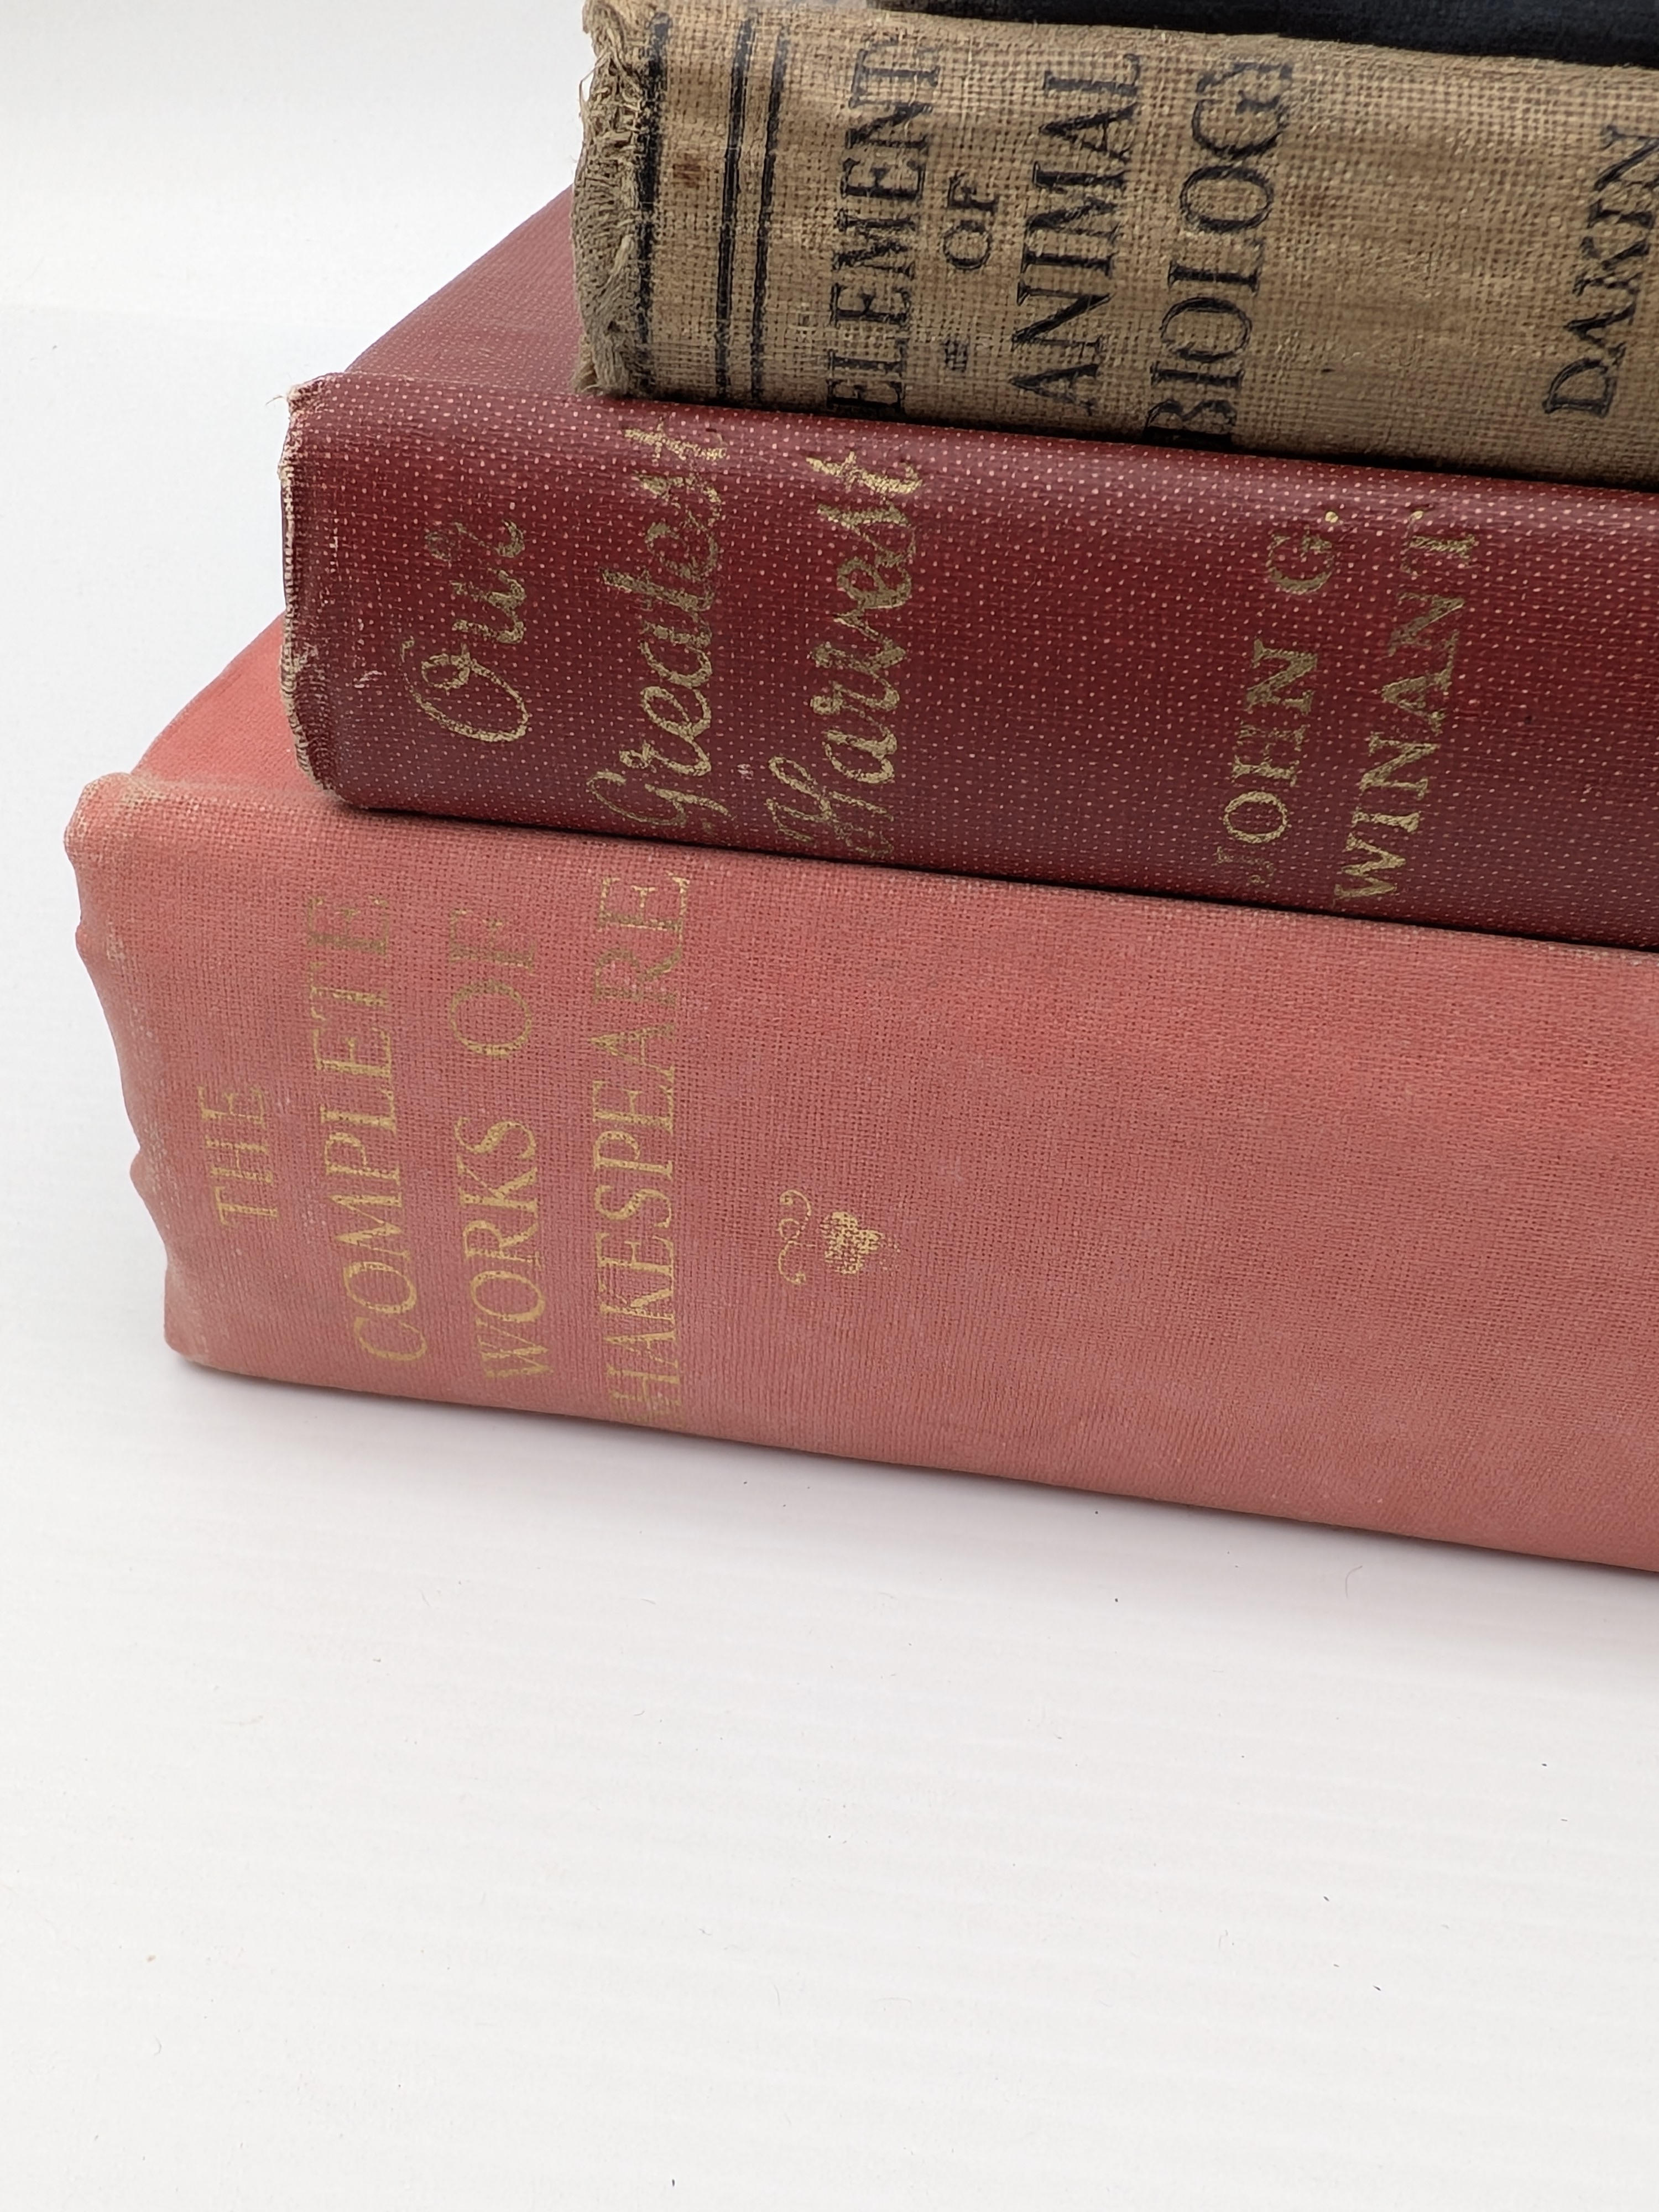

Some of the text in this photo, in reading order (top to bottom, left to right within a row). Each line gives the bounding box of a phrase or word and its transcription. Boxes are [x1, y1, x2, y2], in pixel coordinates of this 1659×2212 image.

[826, 36, 941, 414] ELEMENT
[942, 171, 999, 270] OF
[1010, 54, 1141, 414] ANIMAL
[400, 517, 530, 742] Our
[585, 412, 735, 837] Greatest
[765, 445, 922, 855] Harvest
[1266, 510, 1338, 595] G.
[1331, 509, 1478, 907] WINANT
[197, 1085, 278, 1225] THE
[307, 895, 430, 1363] COMPLETE
[447, 907, 554, 1379] WORKS OF
